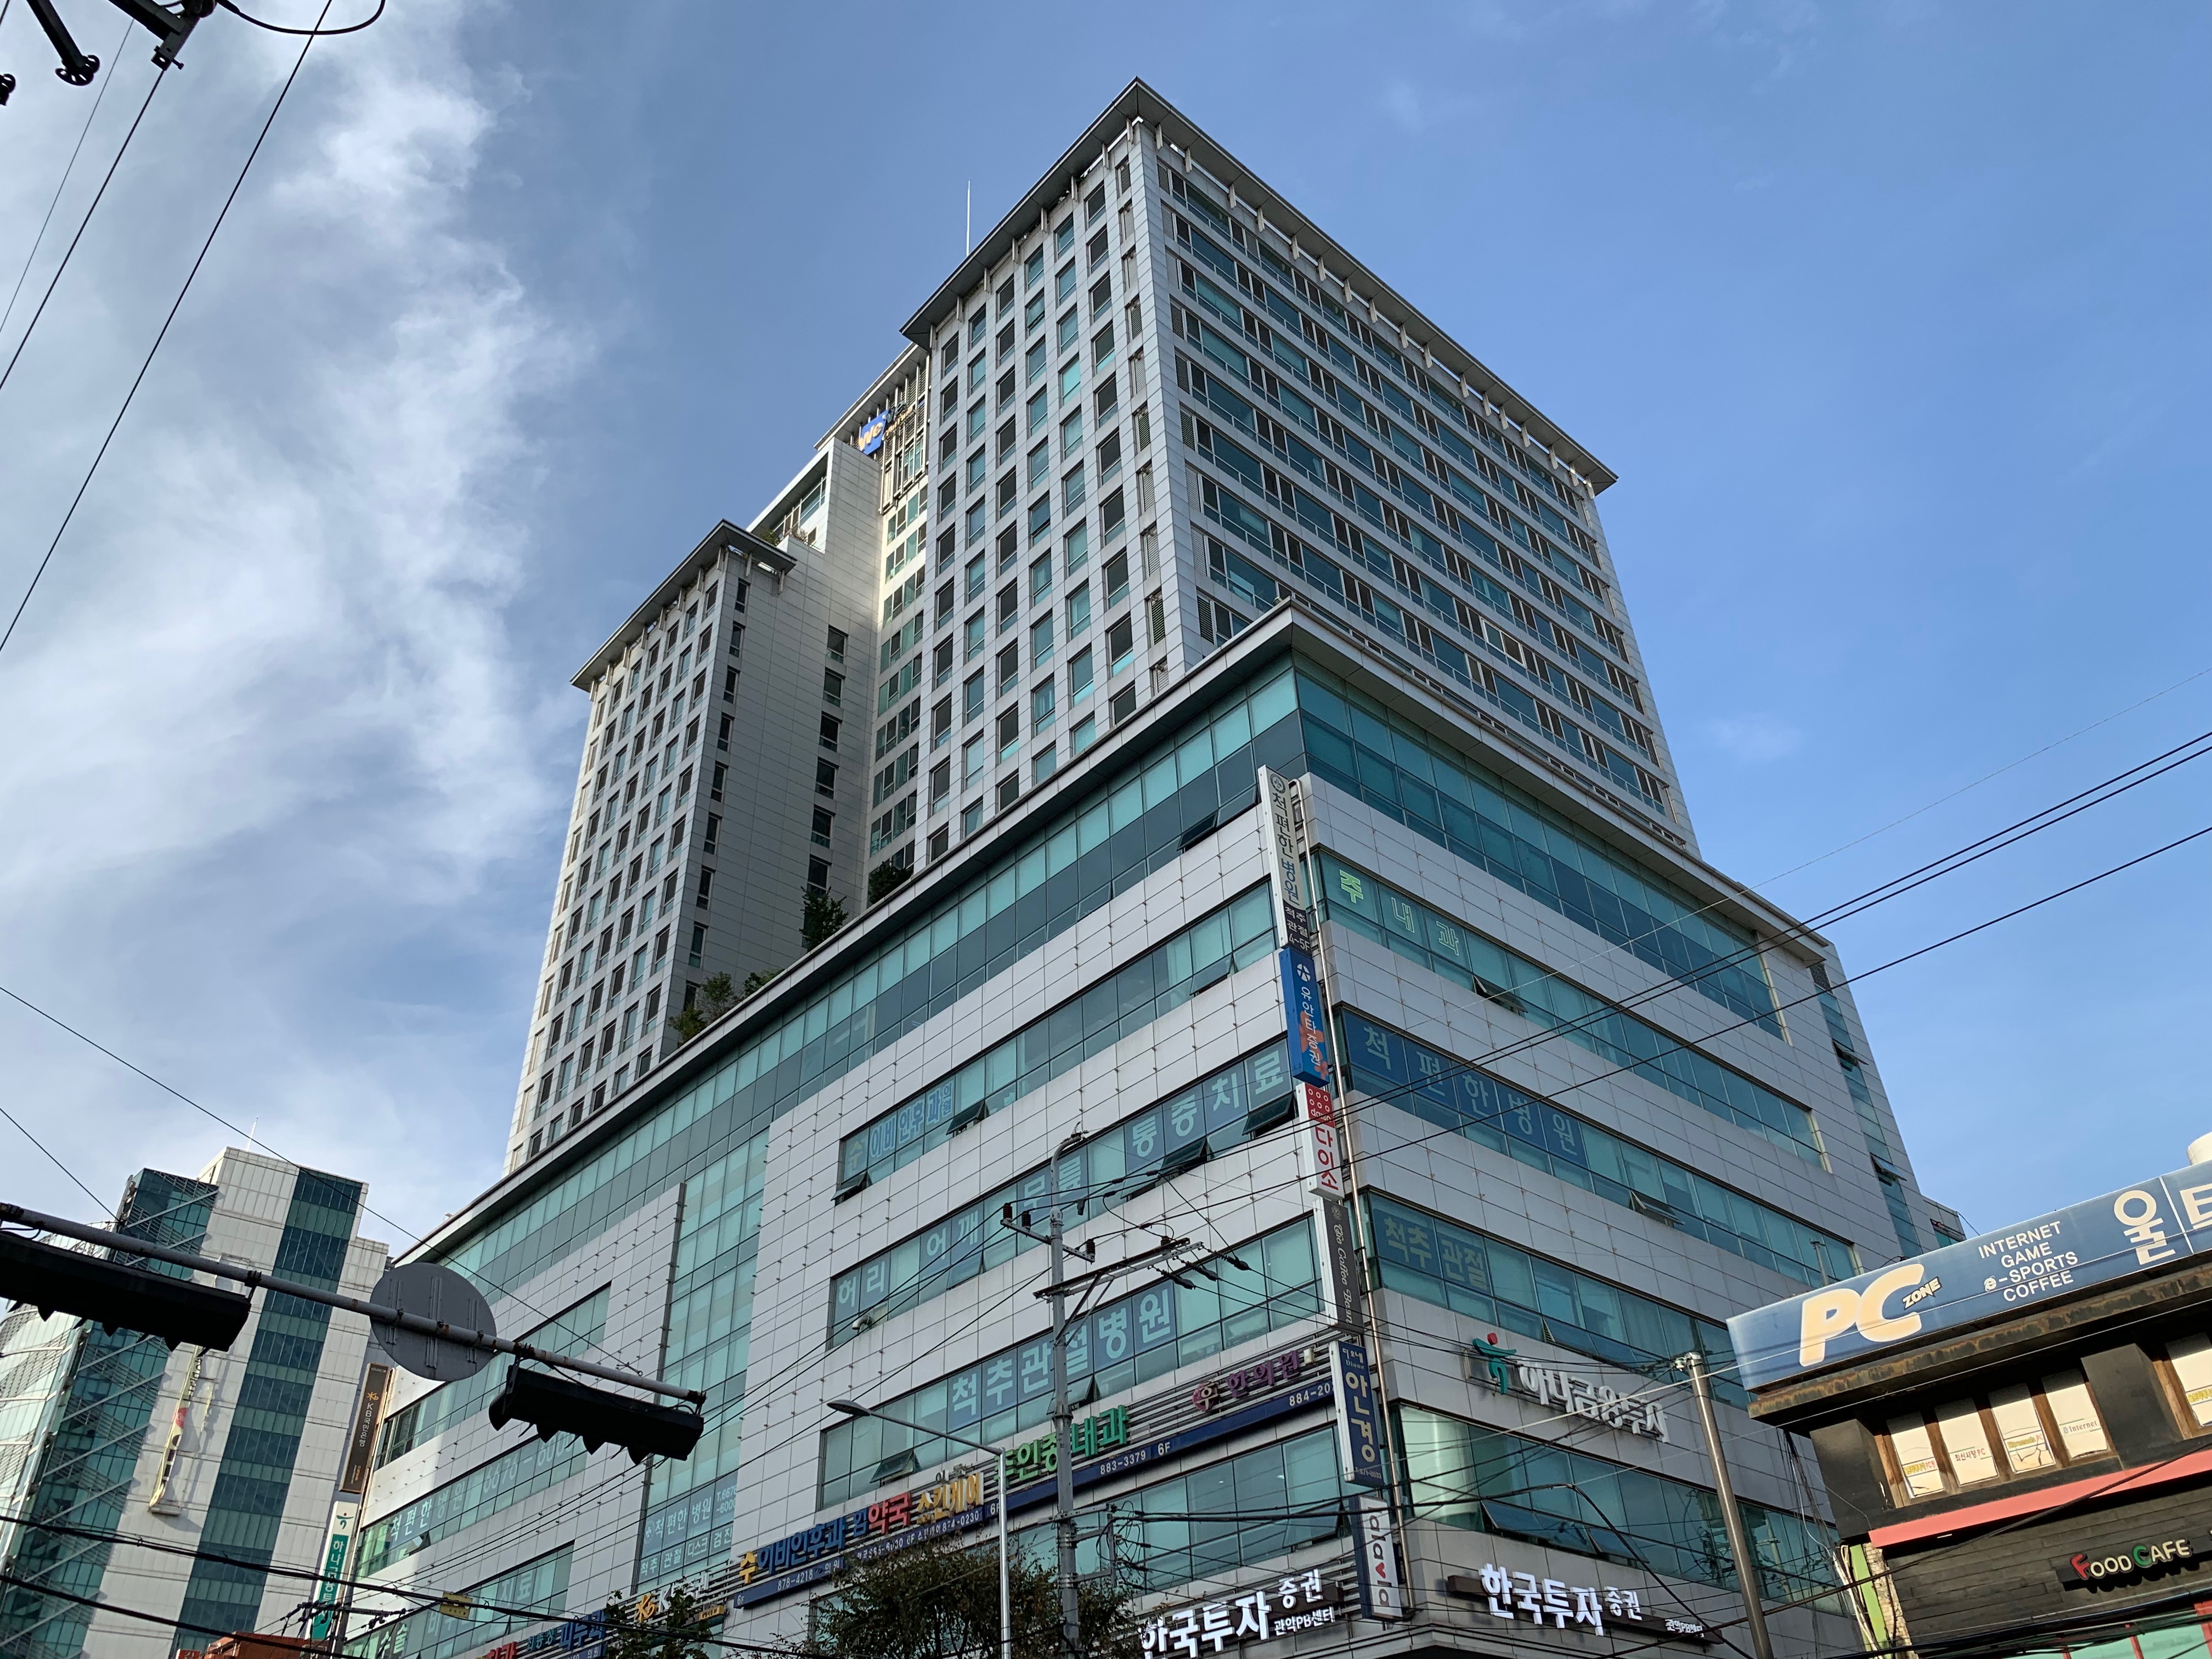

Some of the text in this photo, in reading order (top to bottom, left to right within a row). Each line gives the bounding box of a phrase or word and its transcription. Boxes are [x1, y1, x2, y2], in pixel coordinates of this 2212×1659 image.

[1273, 792, 1300, 906] 척편한병원
[1285, 906, 1306, 923] 척추
[1286, 919, 1308, 938] 관절
[1340, 869, 1459, 957] 주내과
[1289, 933, 1311, 952] 4~5F
[1302, 986, 1321, 1066] 유안타증권
[1364, 1024, 1578, 1157] 척편한병원
[1315, 1126, 1339, 1191] 다이소
[1024, 1155, 1081, 1211] 무릎
[838, 1210, 979, 1307] 허리 어깨
[1978, 1221, 2061, 1259] INTERNET
[2000, 1242, 2053, 1268] GAME
[2003, 1271, 2074, 1302] COFFEE
[1343, 1289, 1353, 1324] Bean
[1799, 1263, 1943, 1367] PC ZONE
[952, 1289, 1171, 1415] 척추관절병원
[1346, 1359, 1365, 1370] Dione
[1227, 1350, 1300, 1398] 한의원
[1289, 1382, 1334, 1407] 884-20
[1517, 1359, 1670, 1443] 하나금융투자
[1345, 1372, 1375, 1463] 안경
[2069, 1420, 2098, 1433] Internet
[1158, 1441, 1171, 1456] 6F
[1977, 1448, 1986, 1457] PC
[2036, 1433, 2044, 1442] PC
[1100, 1450, 1147, 1475] 883-3379
[391, 1481, 465, 1541] 척편한병원
[640, 1527, 732, 1576] 척추 관절 디스크 검진
[2070, 1538, 2191, 1579] FOOD CAFE
[777, 1569, 813, 1591] 878-4218
[1278, 1568, 1324, 1609] 증권
[1479, 1562, 1643, 1637] 한국투자 증권
[736, 1595, 744, 1606] 6F
[1274, 1606, 1336, 1637] 관악PB센터
